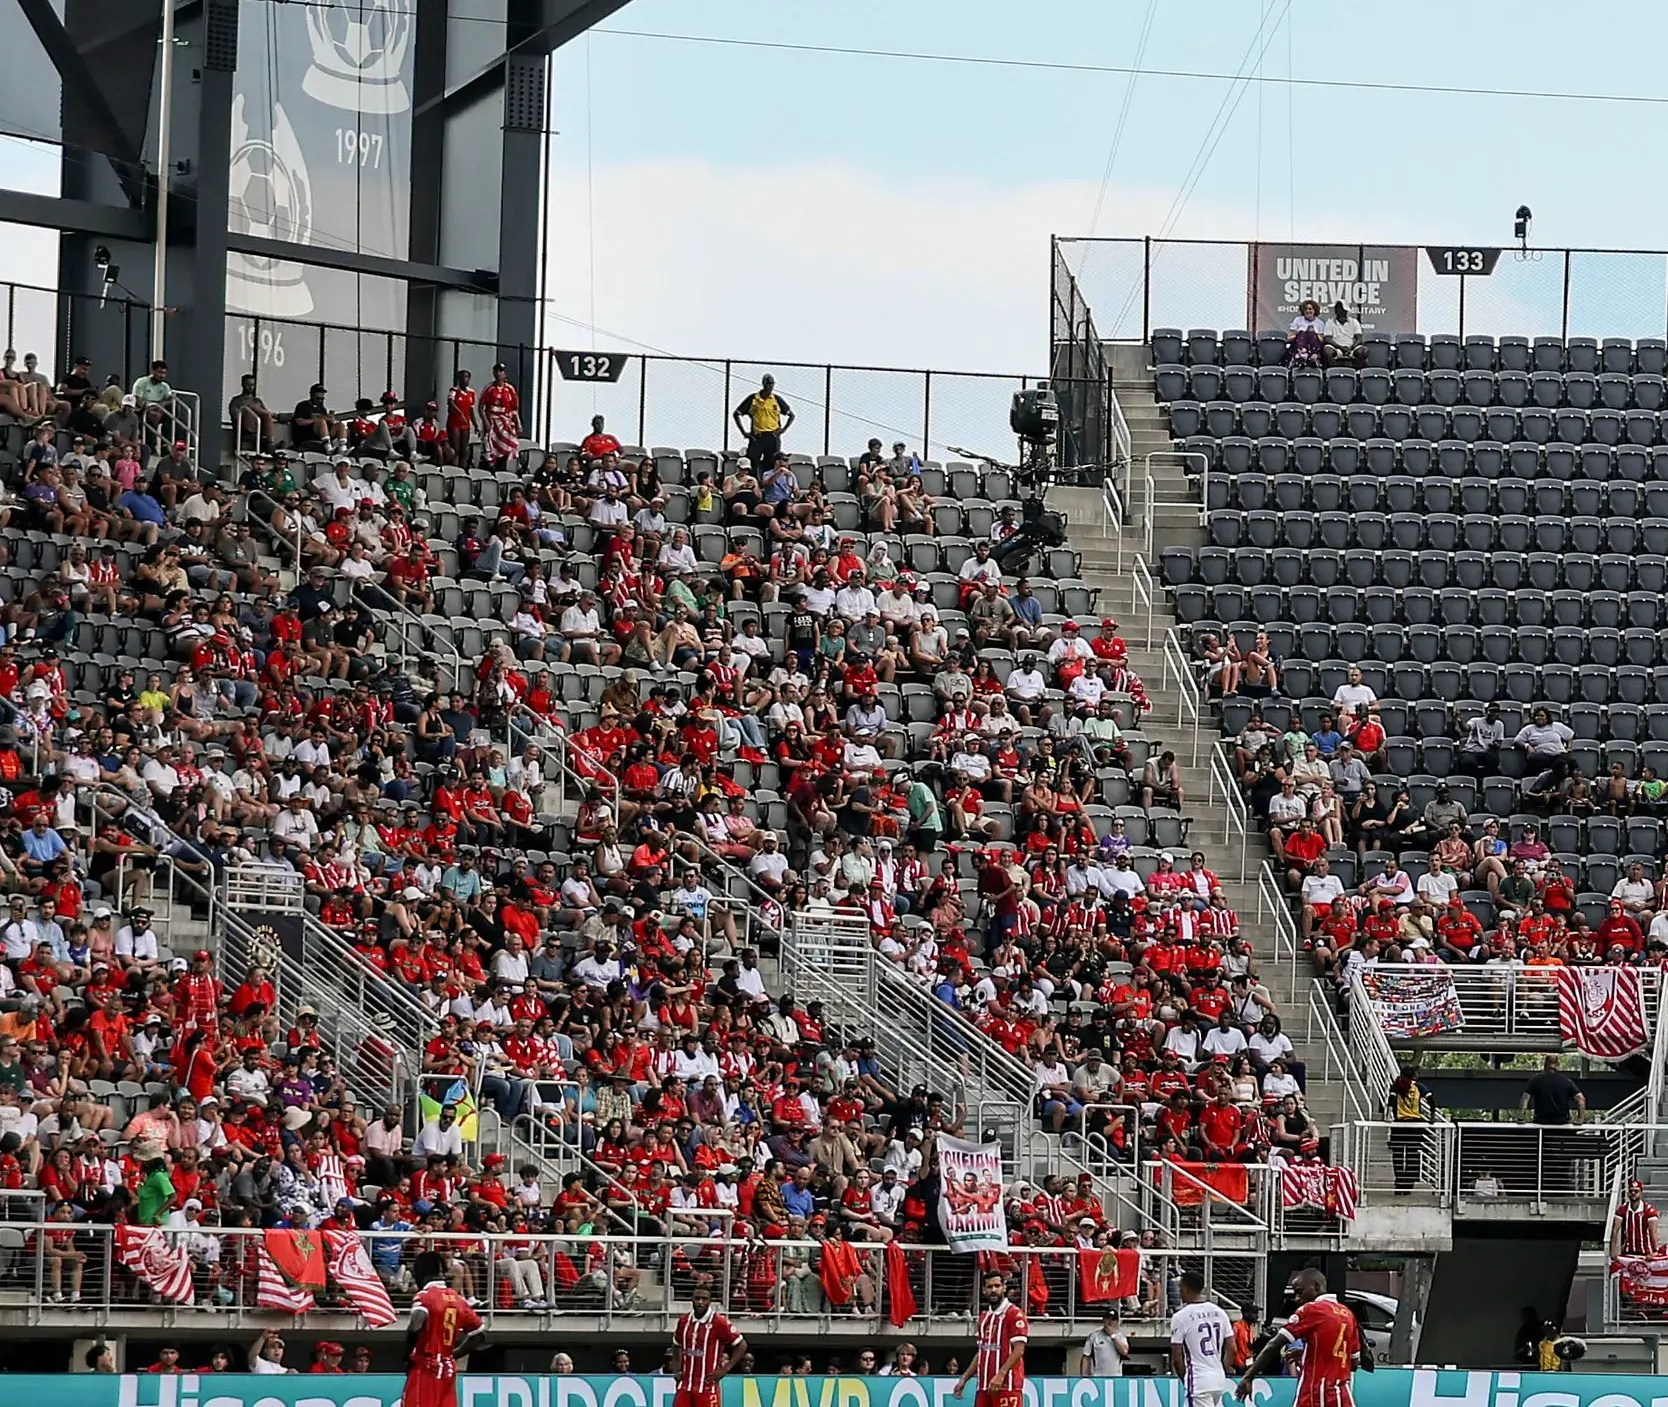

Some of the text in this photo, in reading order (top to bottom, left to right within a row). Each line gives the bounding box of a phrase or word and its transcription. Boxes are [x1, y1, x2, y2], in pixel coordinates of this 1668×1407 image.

[334, 126, 385, 170] 1997
[1276, 258, 1389, 282] UNITED IN
[1443, 251, 1483, 272] 133
[1284, 280, 1380, 304] SERVICE
[237, 324, 285, 368] 1996
[571, 355, 610, 377] 132
[443, 1307, 457, 1346] 9
[1198, 1323, 1221, 1356] 21
[1332, 1322, 1348, 1369] 4
